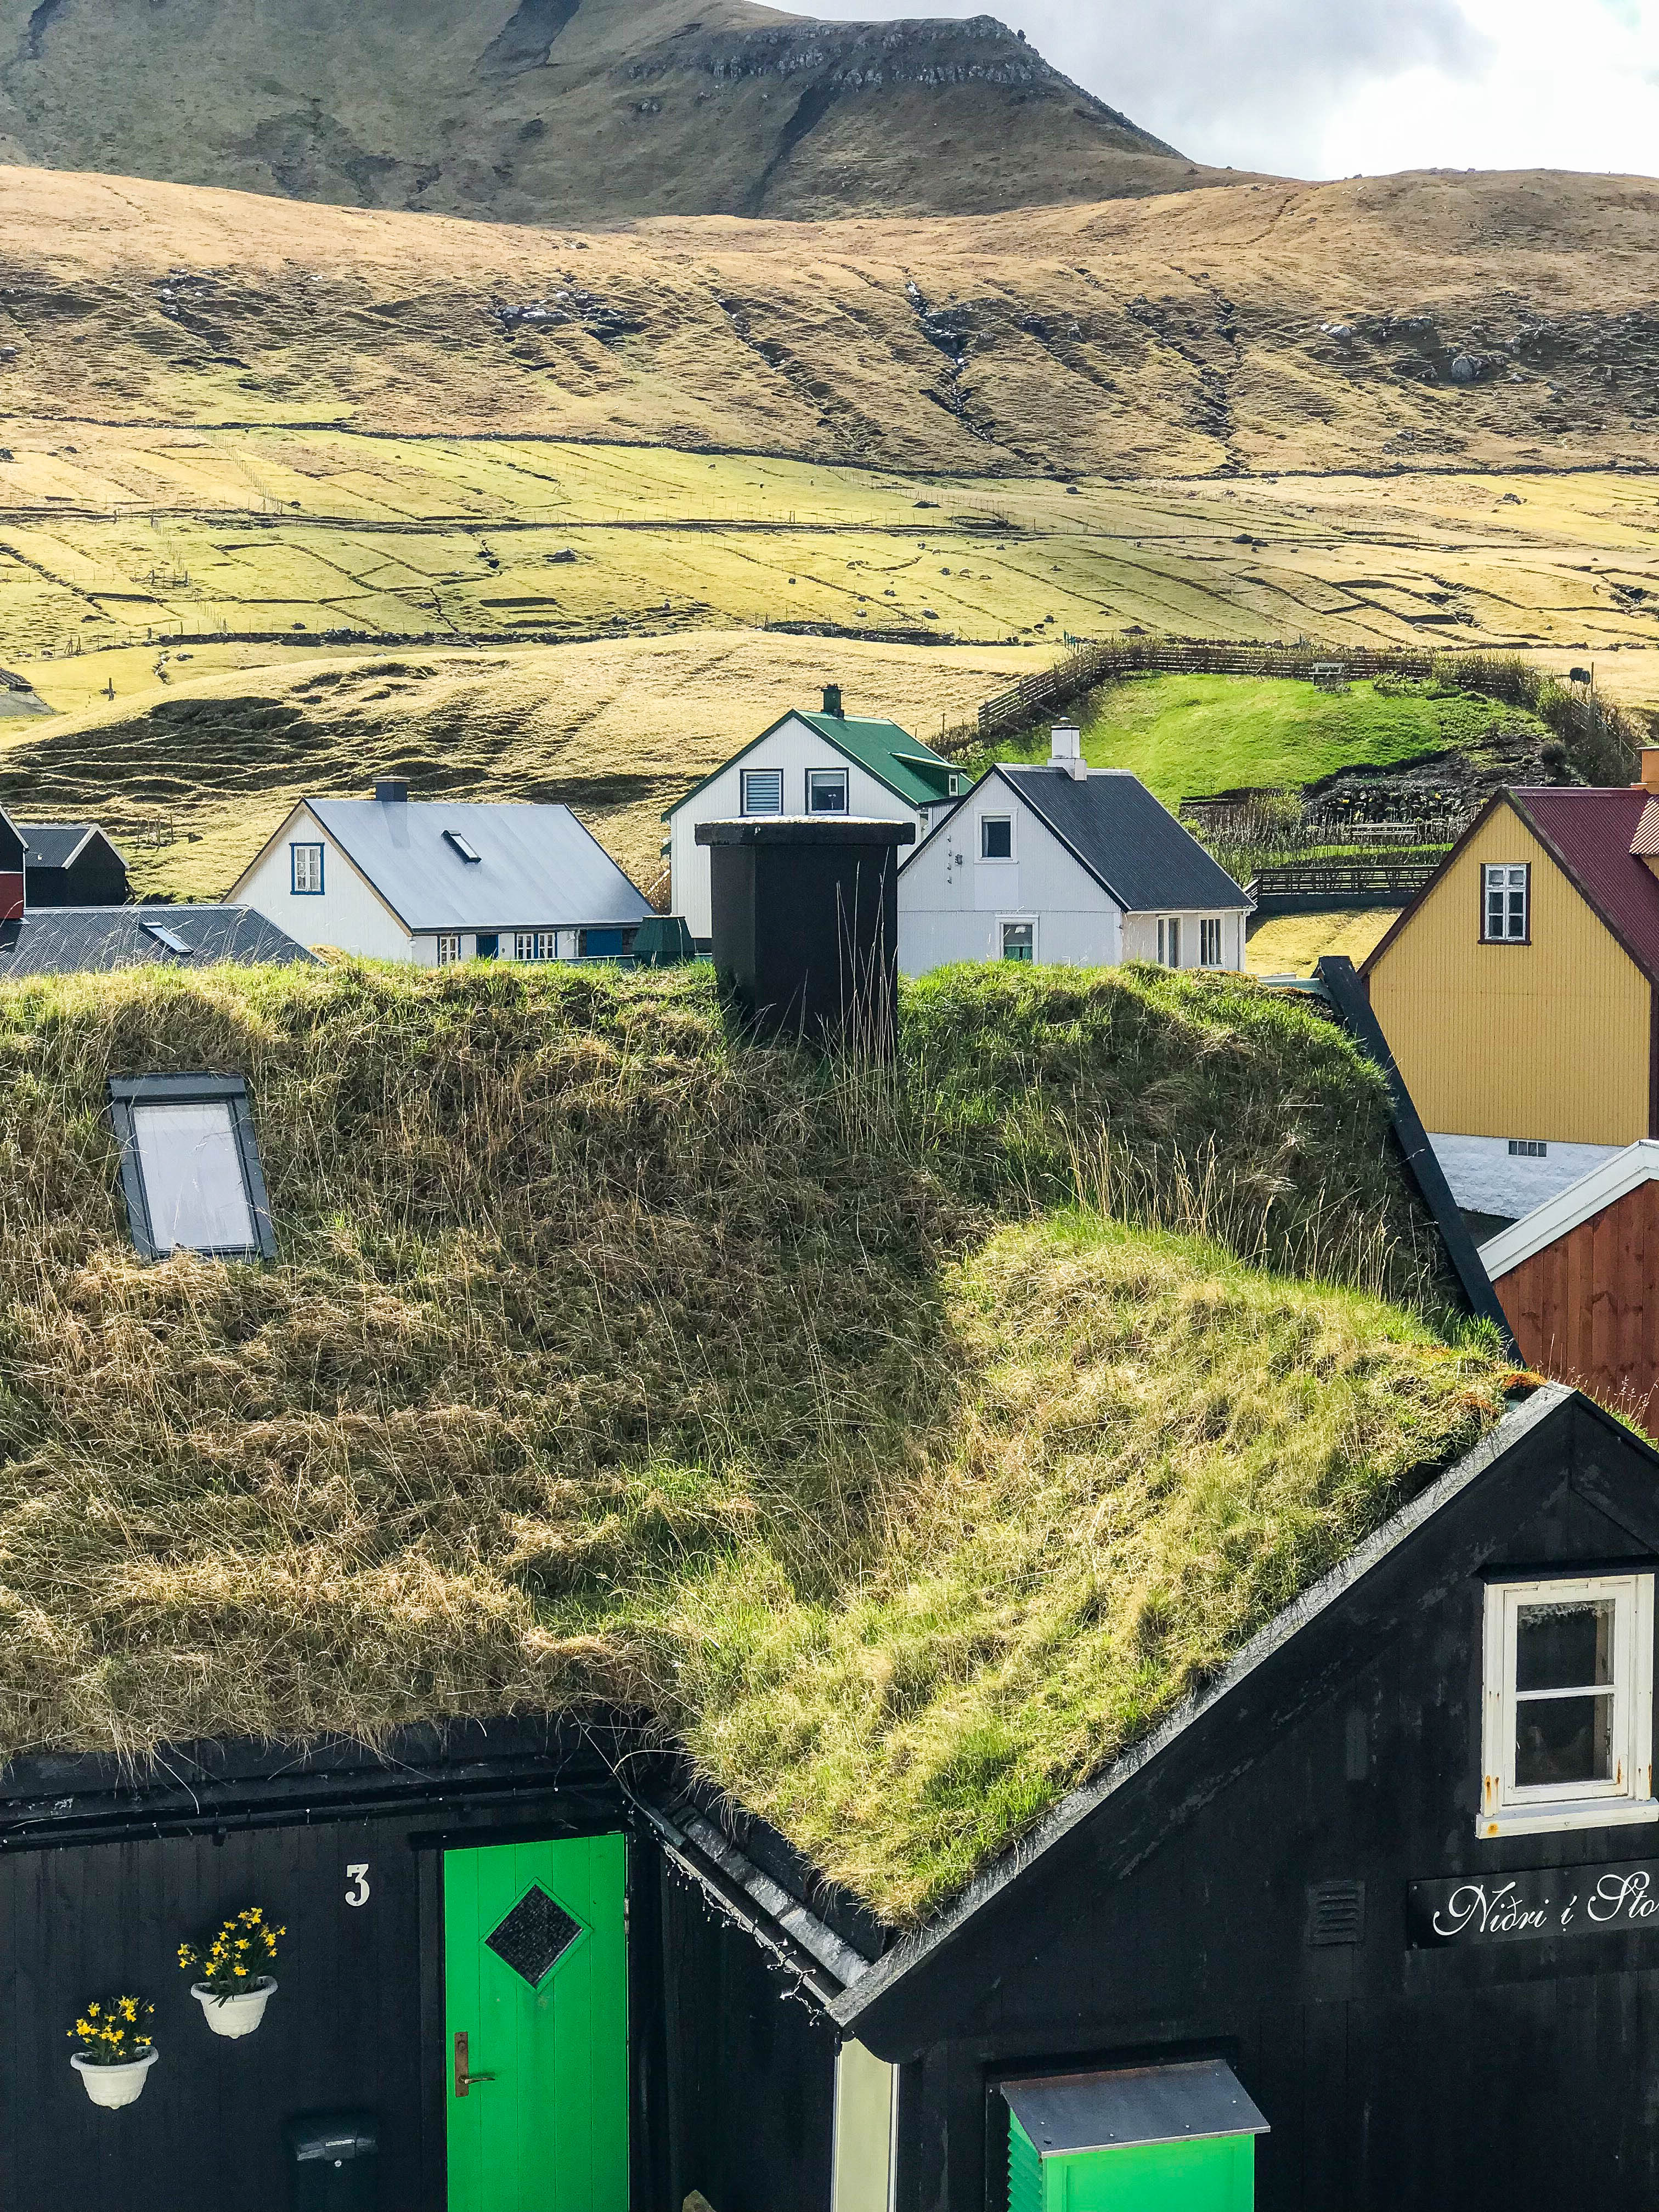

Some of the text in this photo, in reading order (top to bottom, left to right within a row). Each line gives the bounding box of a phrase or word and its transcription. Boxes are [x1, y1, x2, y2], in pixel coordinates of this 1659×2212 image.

[345, 1863, 370, 1906] 3
[1432, 1881, 1549, 1936] Niðri
[1587, 1871, 1659, 1921] Sto
